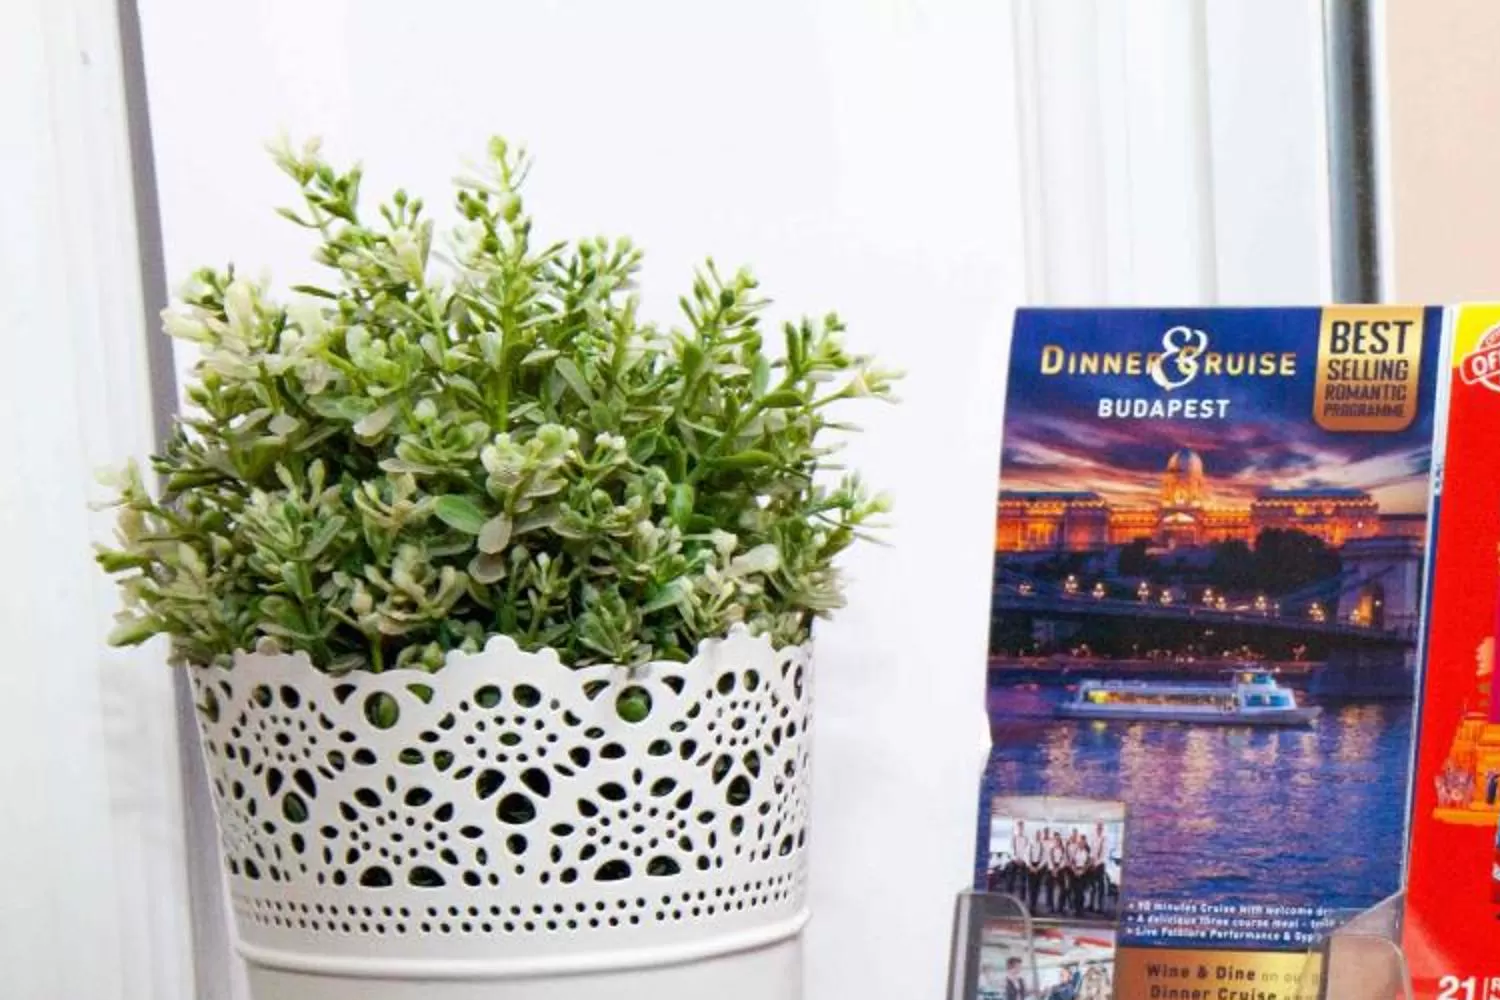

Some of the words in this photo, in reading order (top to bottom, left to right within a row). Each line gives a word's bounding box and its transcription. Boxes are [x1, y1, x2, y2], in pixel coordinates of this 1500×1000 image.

[1330, 320, 1414, 355] BEST
[1327, 359, 1409, 382] SELLING
[1324, 383, 1408, 401] ROMANTIC
[1098, 398, 1230, 419] BUDAPEST
[1147, 964, 1190, 979] Wine
[1216, 965, 1256, 981] Dine
[1151, 985, 1211, 1000] Dinner
